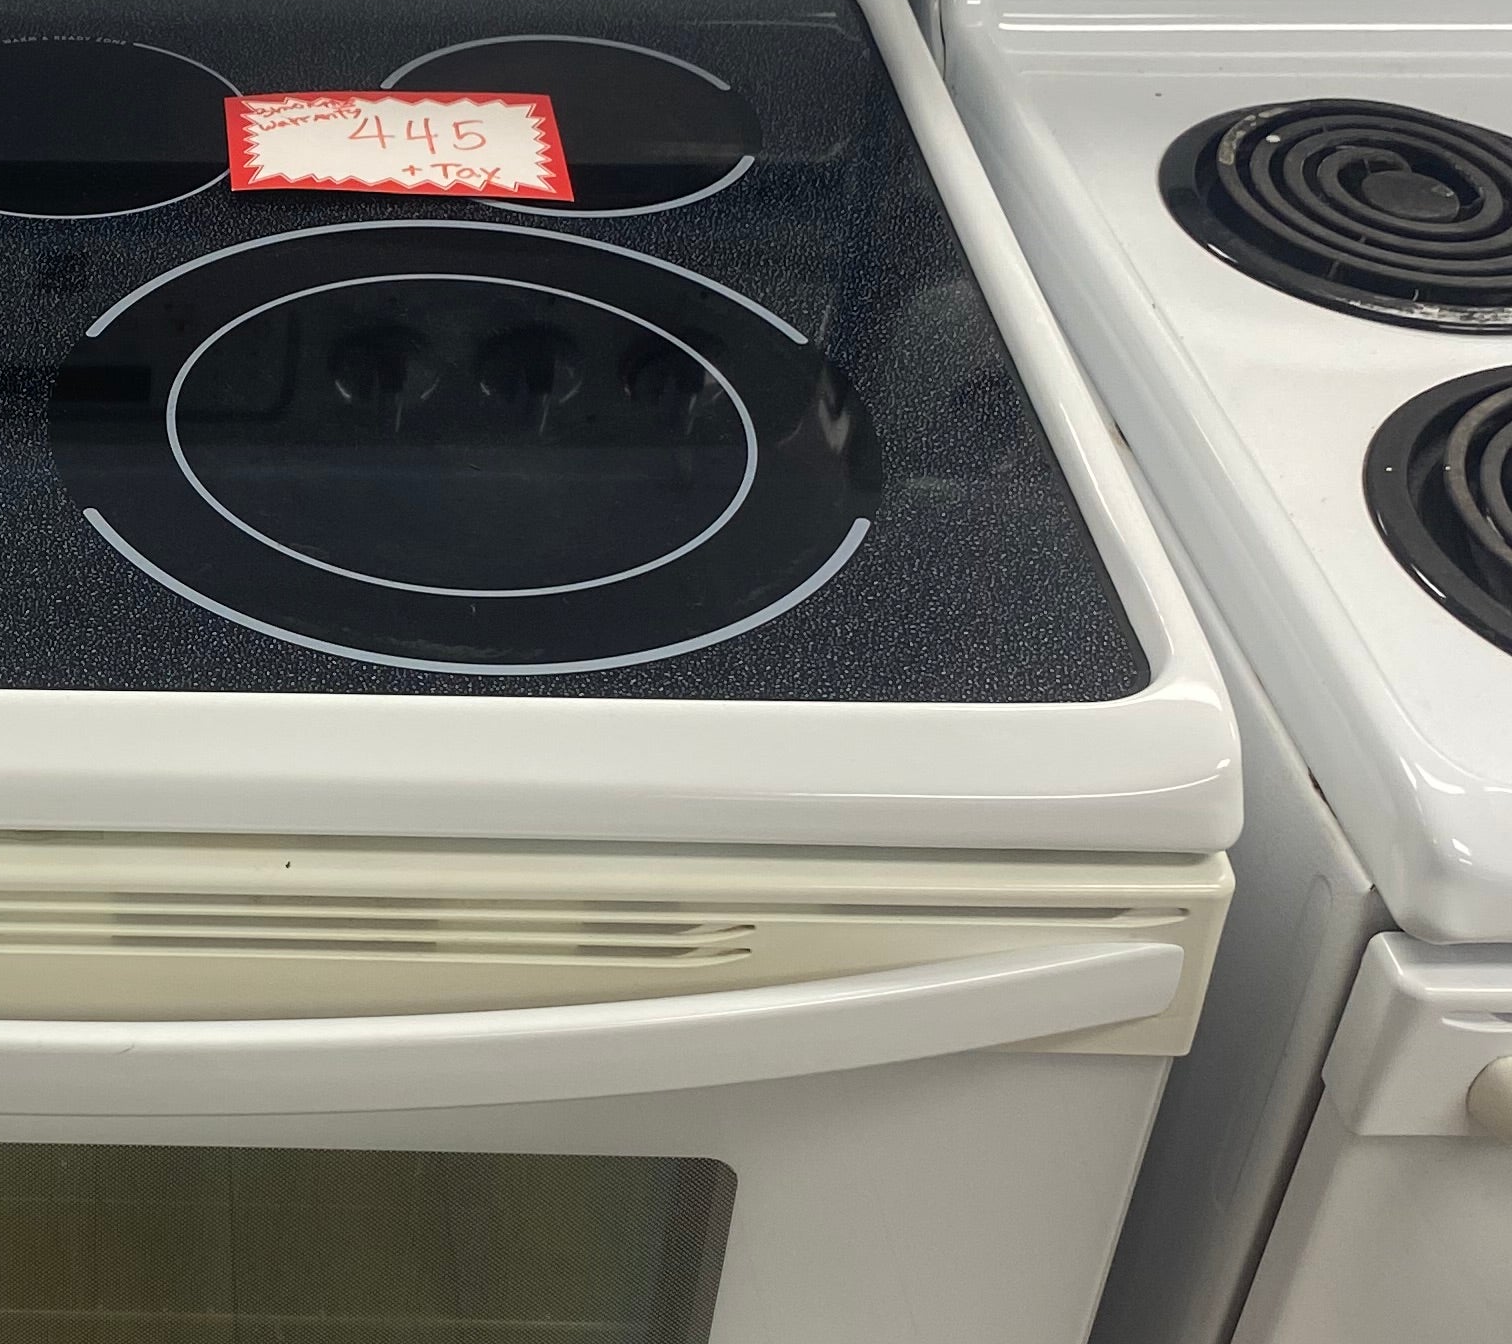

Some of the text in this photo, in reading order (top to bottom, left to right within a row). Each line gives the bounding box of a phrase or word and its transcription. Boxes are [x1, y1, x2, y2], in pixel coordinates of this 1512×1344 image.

[96, 36, 127, 46] ZONE
[348, 114, 488, 155] 445
[430, 162, 502, 181] Tax
